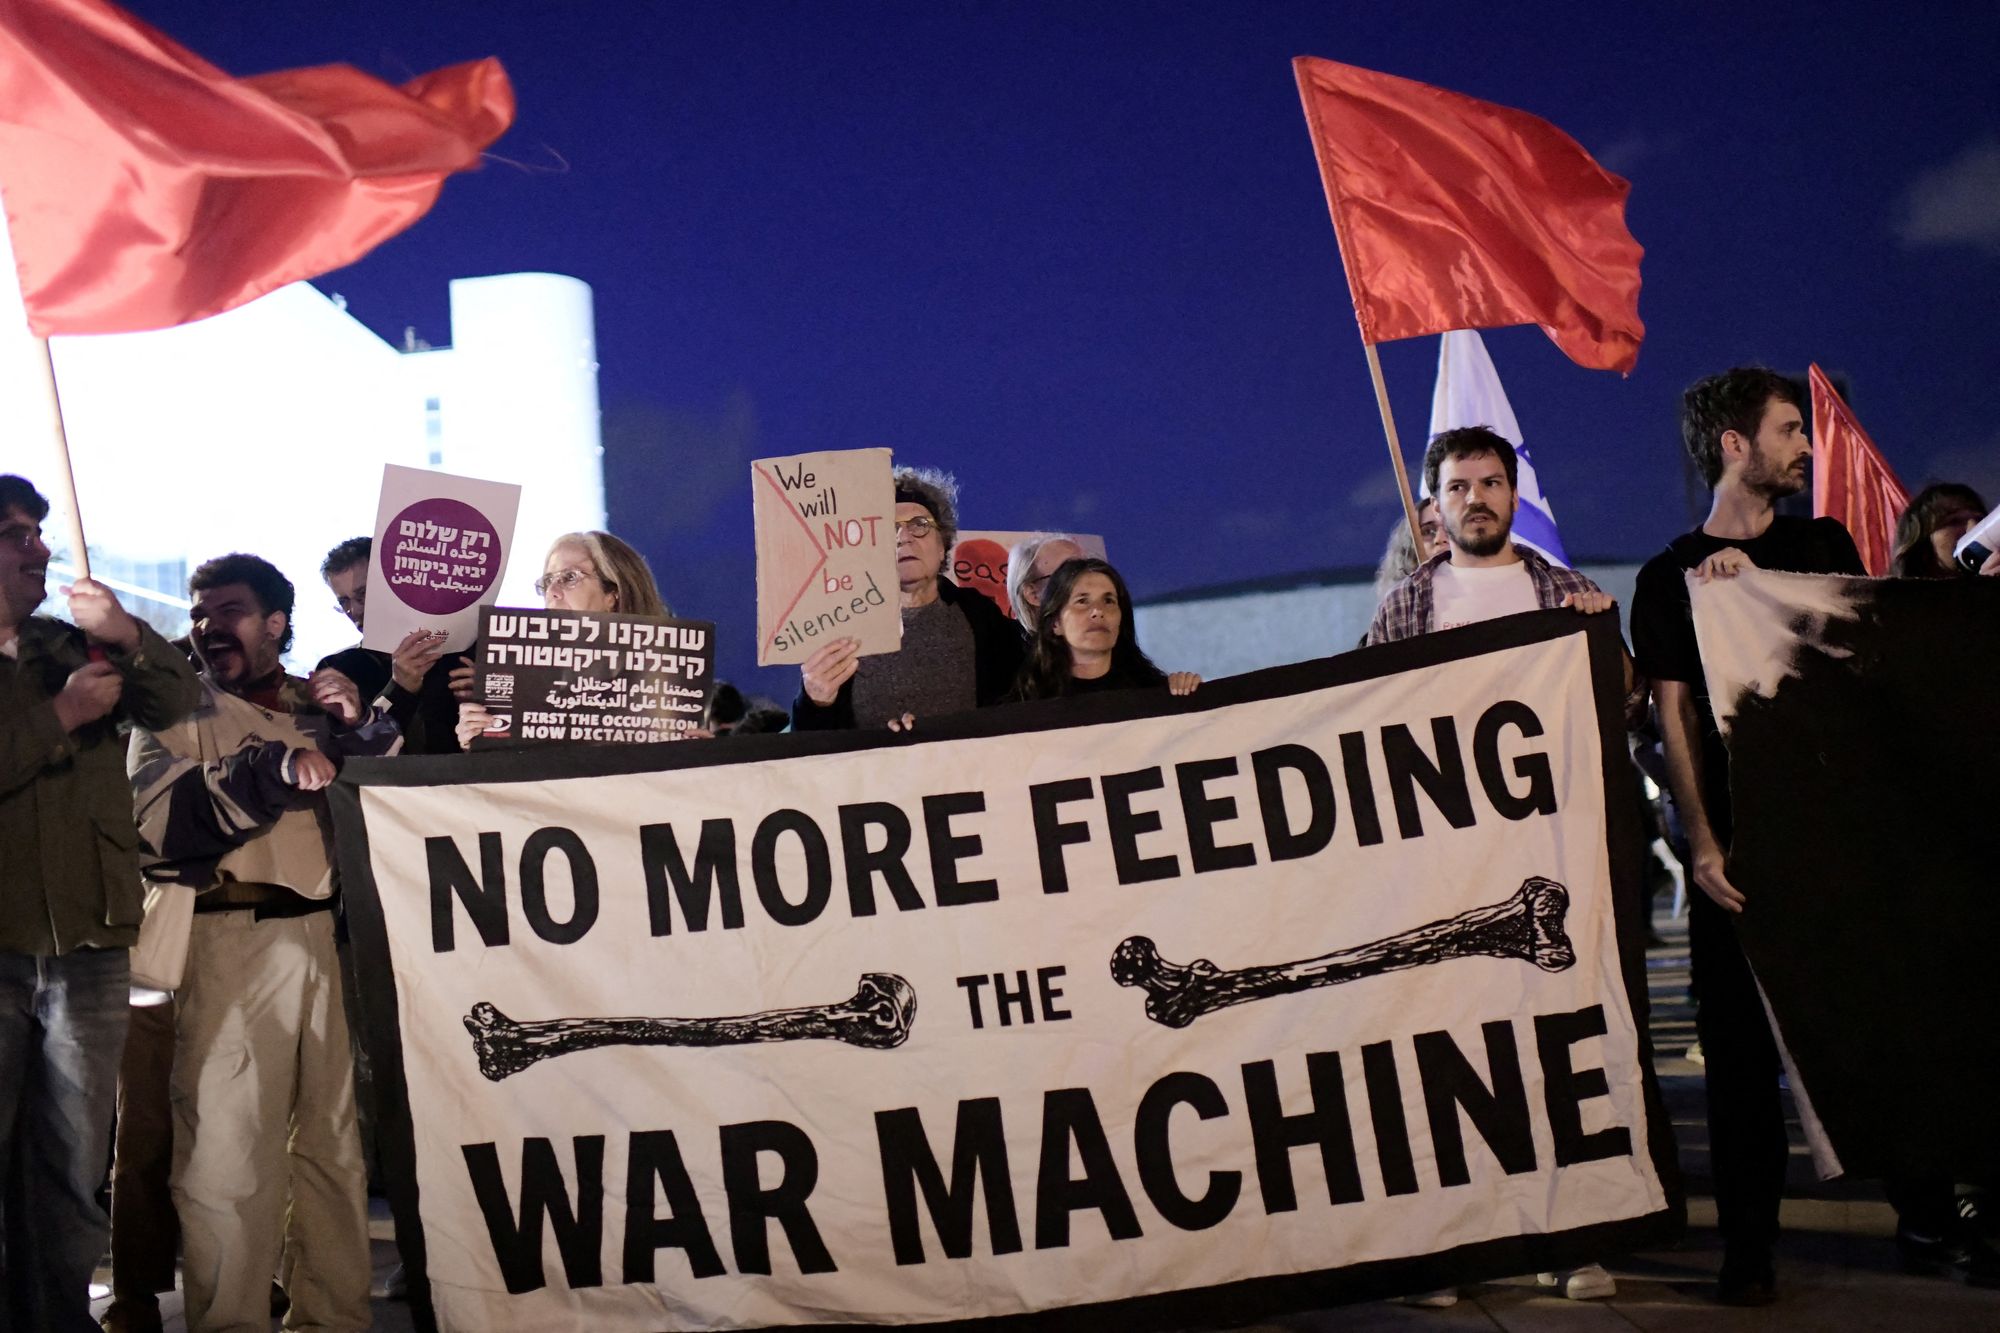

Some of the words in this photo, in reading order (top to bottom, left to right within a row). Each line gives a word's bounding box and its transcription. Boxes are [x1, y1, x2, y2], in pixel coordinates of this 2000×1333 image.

[774, 462, 816, 490] We
[799, 487, 837, 518] will
[400, 520, 458, 543] שלום
[461, 530, 491, 549] רק
[824, 516, 882, 550] NOT
[396, 538, 447, 556] السلام
[394, 555, 449, 575] ביטחון
[451, 564, 487, 578] יביא
[430, 576, 484, 594] سيجلب
[823, 568, 853, 594] be
[774, 571, 885, 652] silenced
[488, 615, 601, 642] לכיבוש
[608, 622, 706, 651] שתקנו
[487, 644, 619, 672] דיקטטורה
[625, 649, 705, 679] קיבלנו
[629, 695, 657, 712] على
[521, 726, 567, 739] NOW
[570, 728, 699, 743] DICTATORSH
[522, 712, 567, 725] FIRST
[569, 714, 600, 726] THE
[602, 715, 698, 731] OCCUPATION
[424, 826, 600, 953] NO
[640, 790, 1001, 938] MORE
[1029, 699, 1559, 895] FEEDING
[956, 965, 1073, 1029] THE
[460, 1119, 839, 1296] WAR
[873, 1003, 1634, 1265] MACHINE
